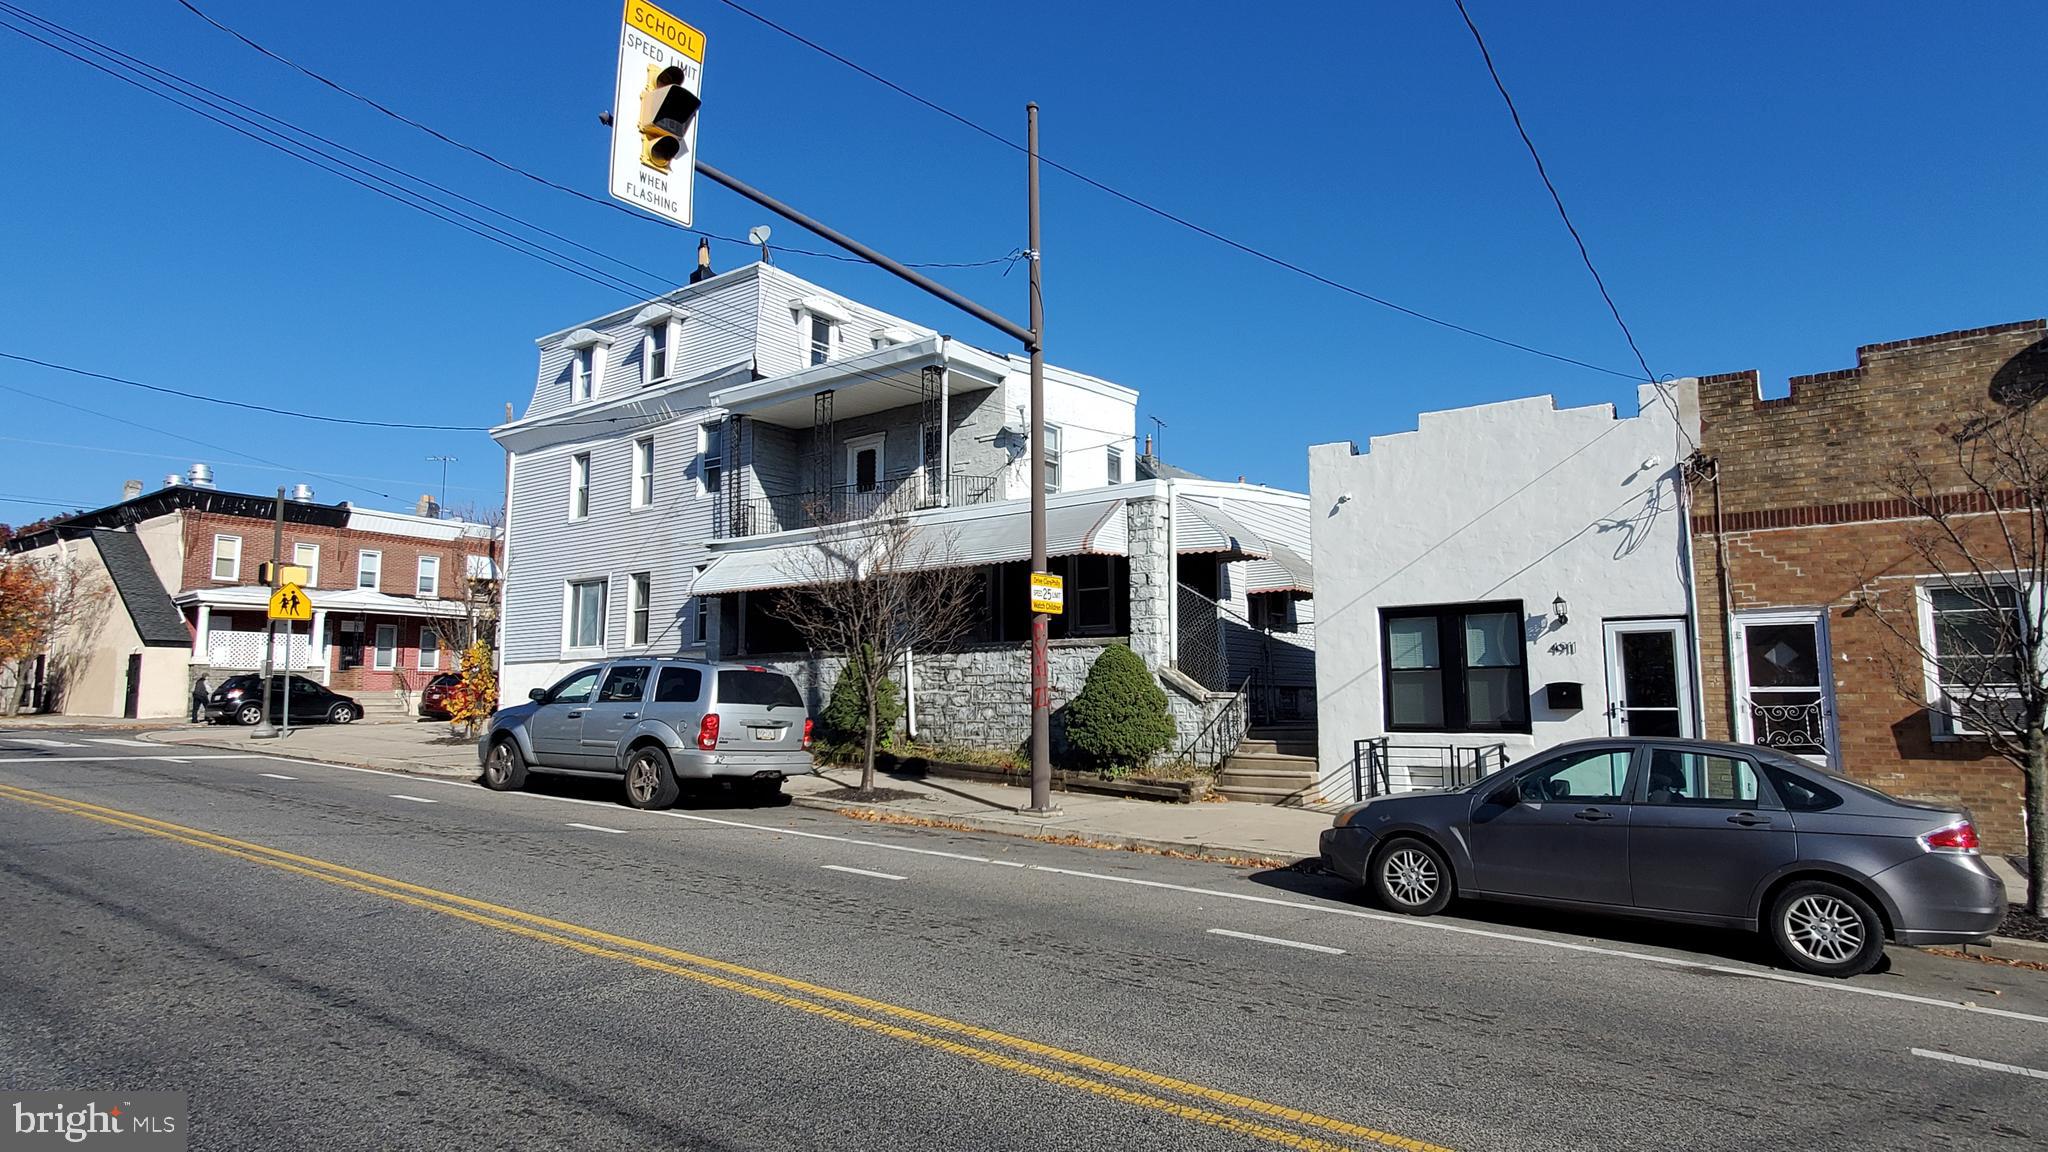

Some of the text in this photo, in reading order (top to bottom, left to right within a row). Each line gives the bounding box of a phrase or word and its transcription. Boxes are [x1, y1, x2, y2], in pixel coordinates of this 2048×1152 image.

[634, 7, 696, 53] SCHOOL
[627, 33, 664, 63] SPEED
[639, 170, 668, 193] WHEN
[626, 182, 678, 213] FLASHING
[1043, 587, 1052, 600] 25
[1547, 641, 1576, 656] 4911
